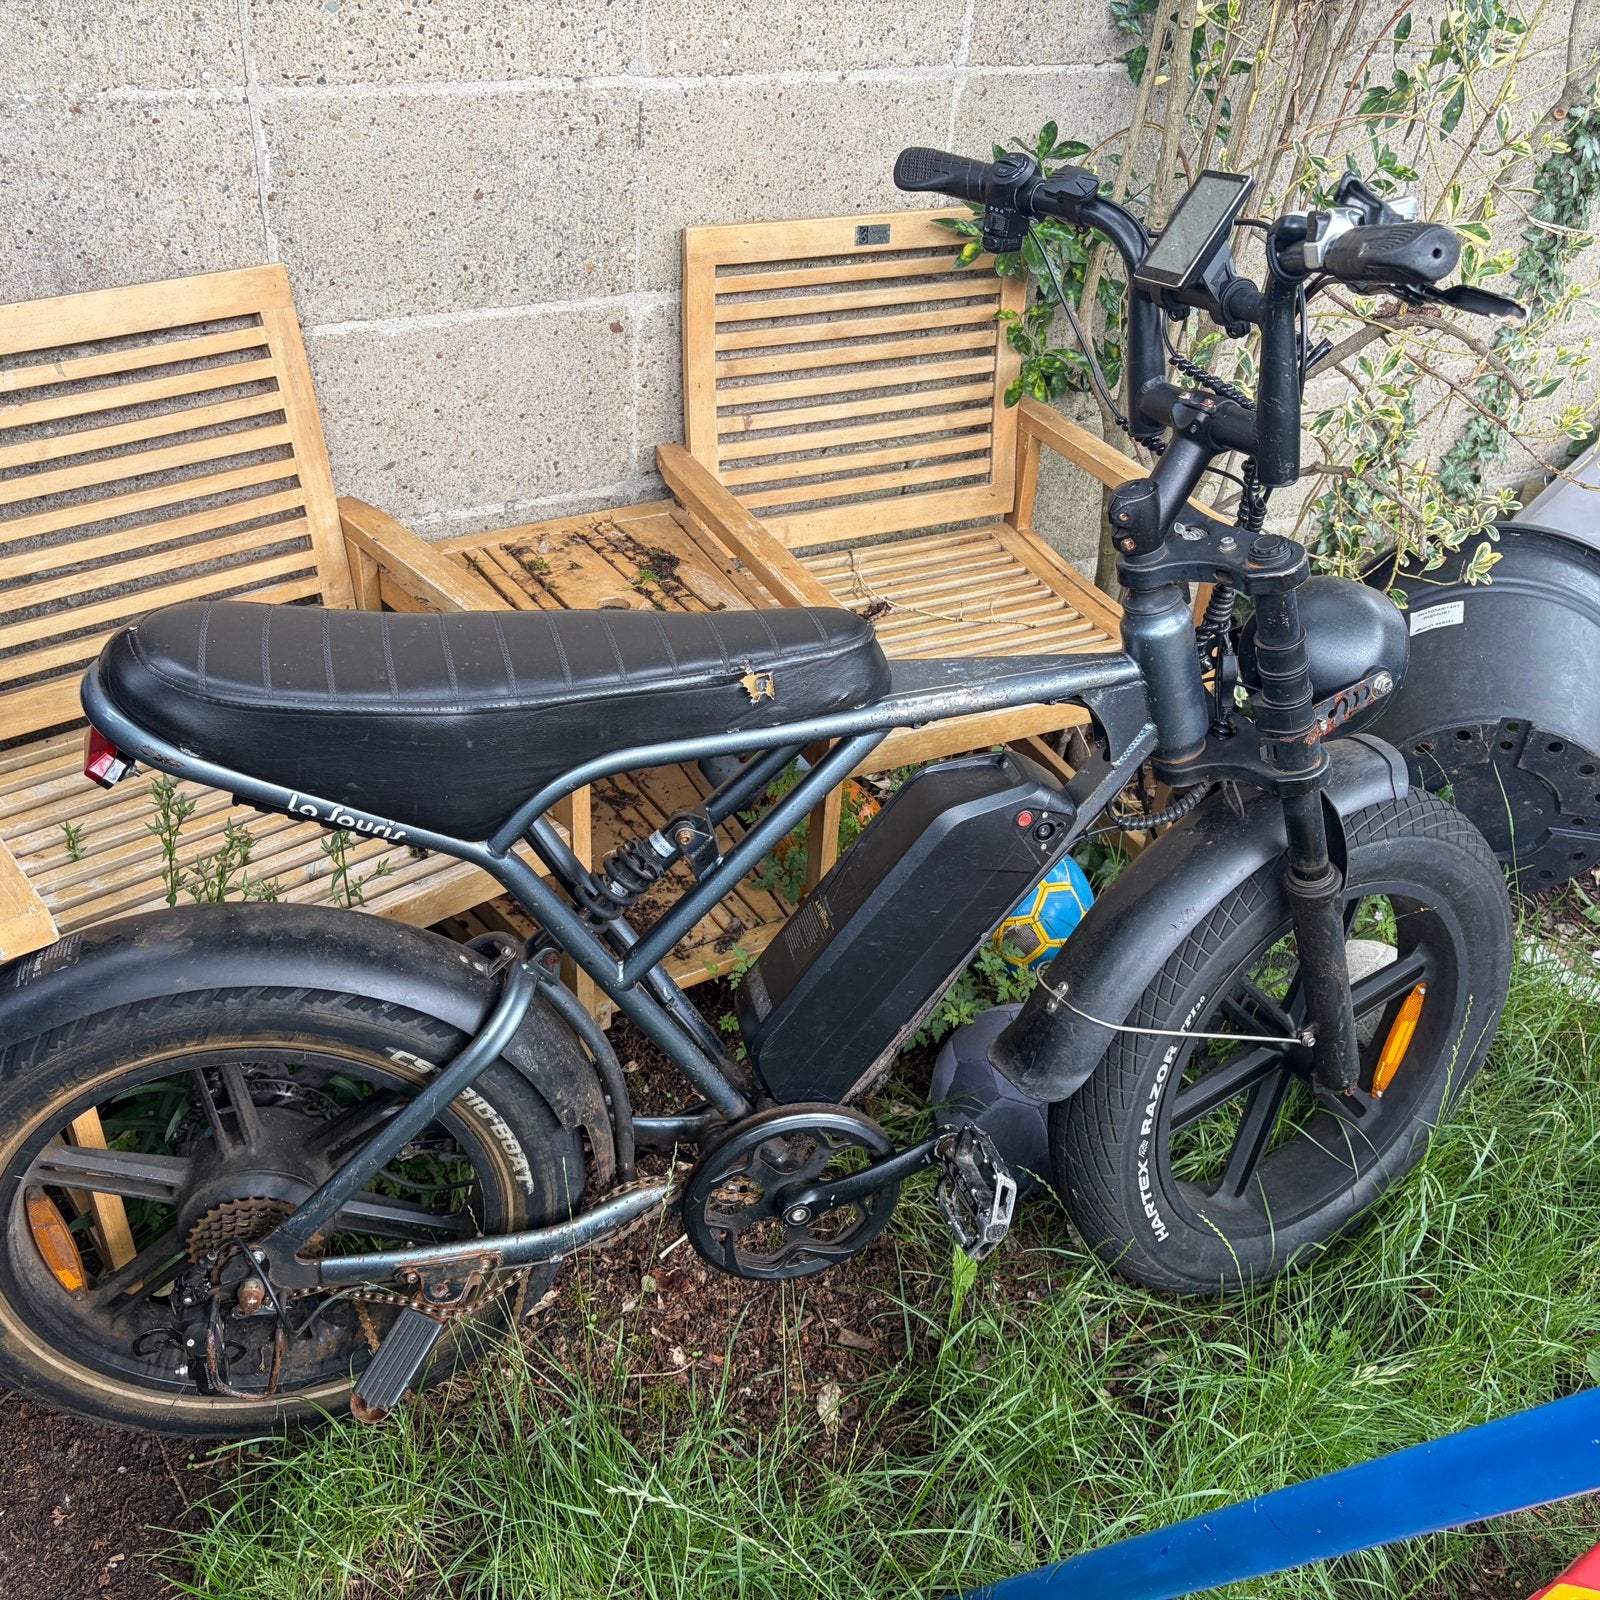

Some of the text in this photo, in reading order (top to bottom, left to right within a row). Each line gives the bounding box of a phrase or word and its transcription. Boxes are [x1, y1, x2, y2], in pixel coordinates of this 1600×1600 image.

[385, 1046, 443, 1075] CS
[1139, 1044, 1178, 1136] RAZOR
[1137, 1157, 1170, 1244] HARTEX
